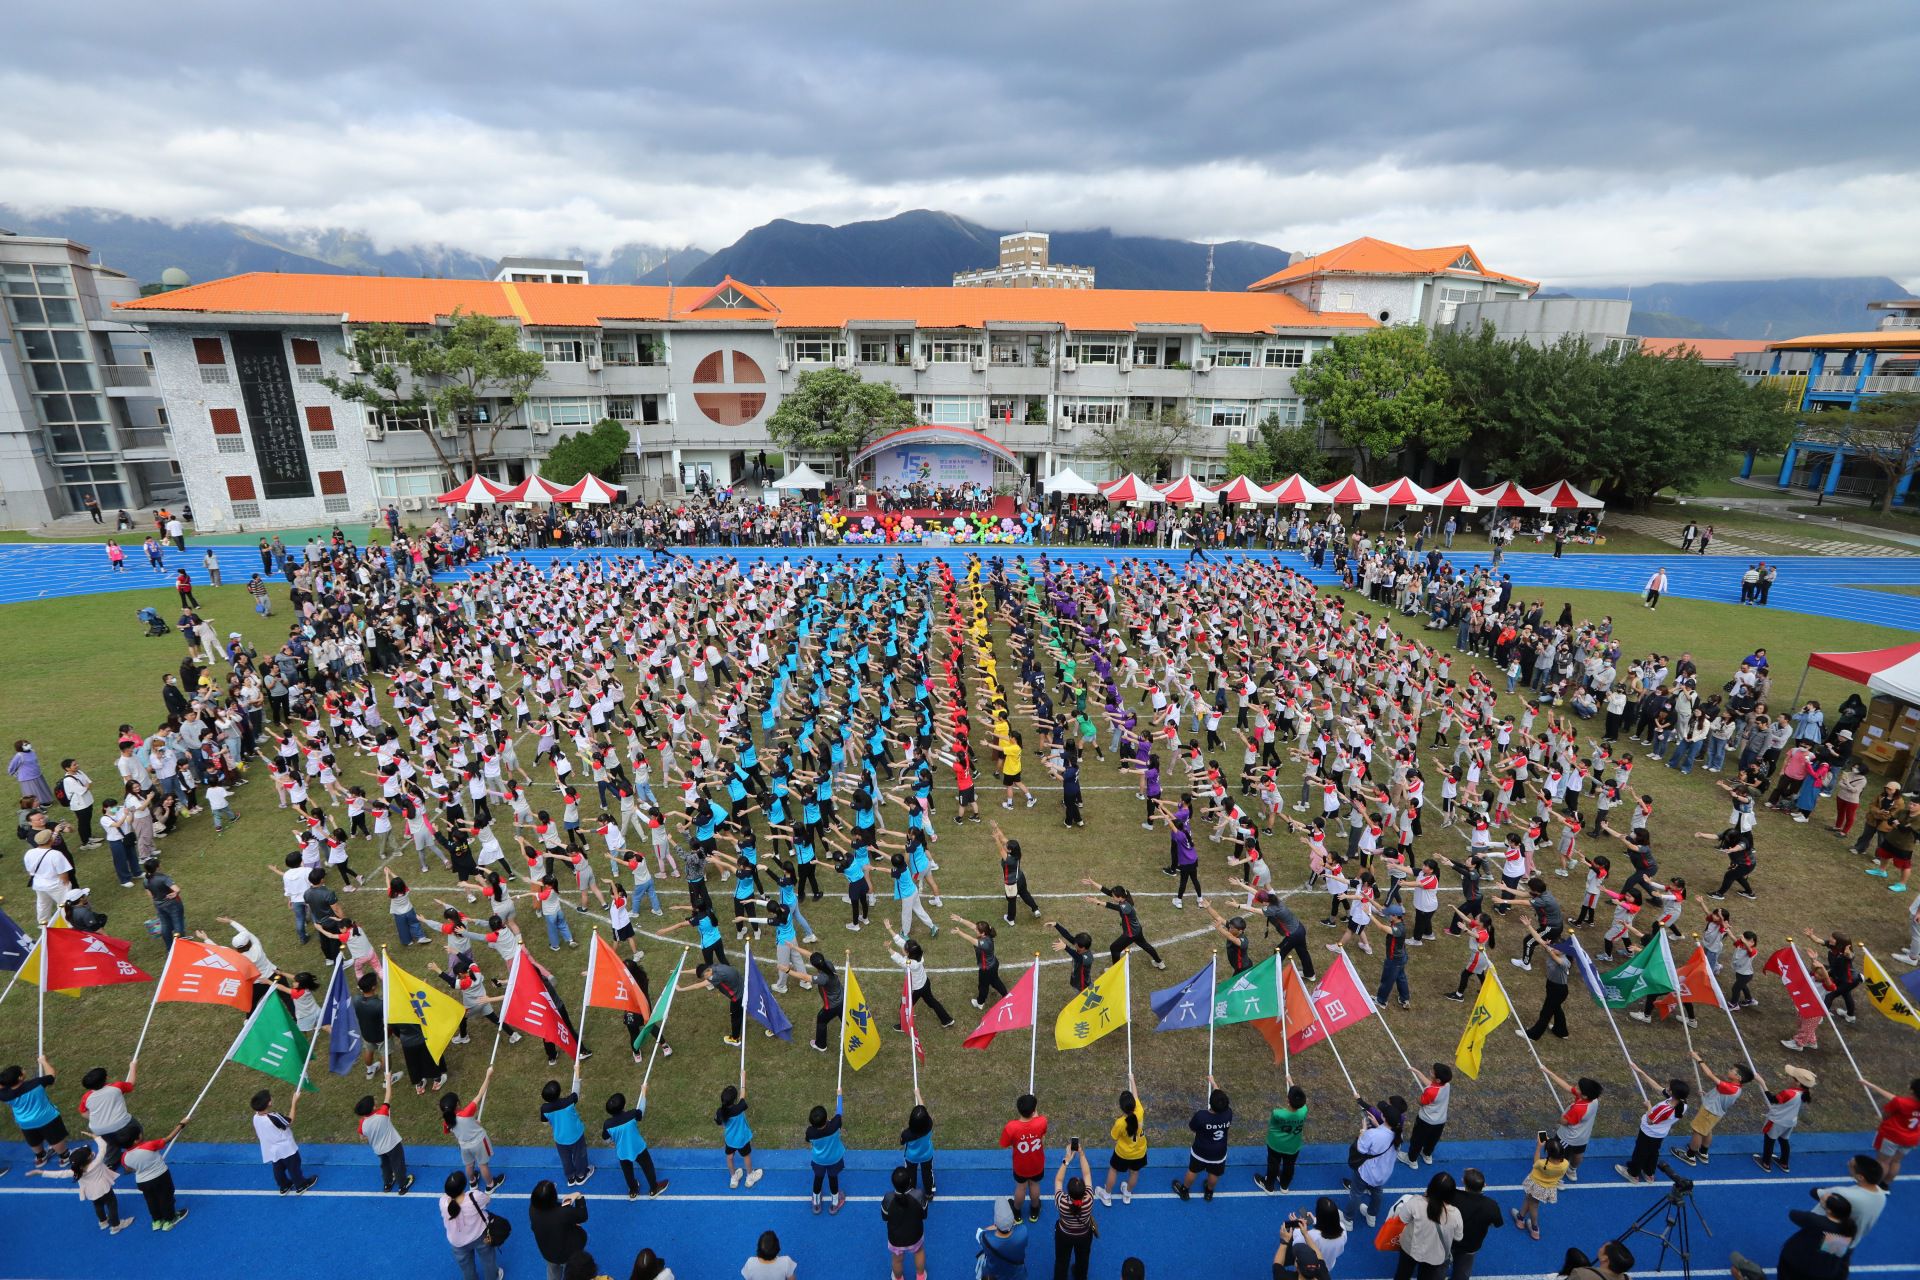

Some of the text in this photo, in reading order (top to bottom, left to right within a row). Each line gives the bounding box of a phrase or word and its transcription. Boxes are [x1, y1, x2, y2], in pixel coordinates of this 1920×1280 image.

[925, 519, 942, 533] 75
[614, 980, 628, 1001] 五
[1179, 1000, 1197, 1022] 六
[1324, 998, 1348, 1023] 四
[260, 1043, 289, 1067] 三
[1205, 1121, 1232, 1130] David
[1020, 1133, 1038, 1141] J.L.
[1212, 1130, 1225, 1141] 3
[1017, 1138, 1042, 1154] 02
